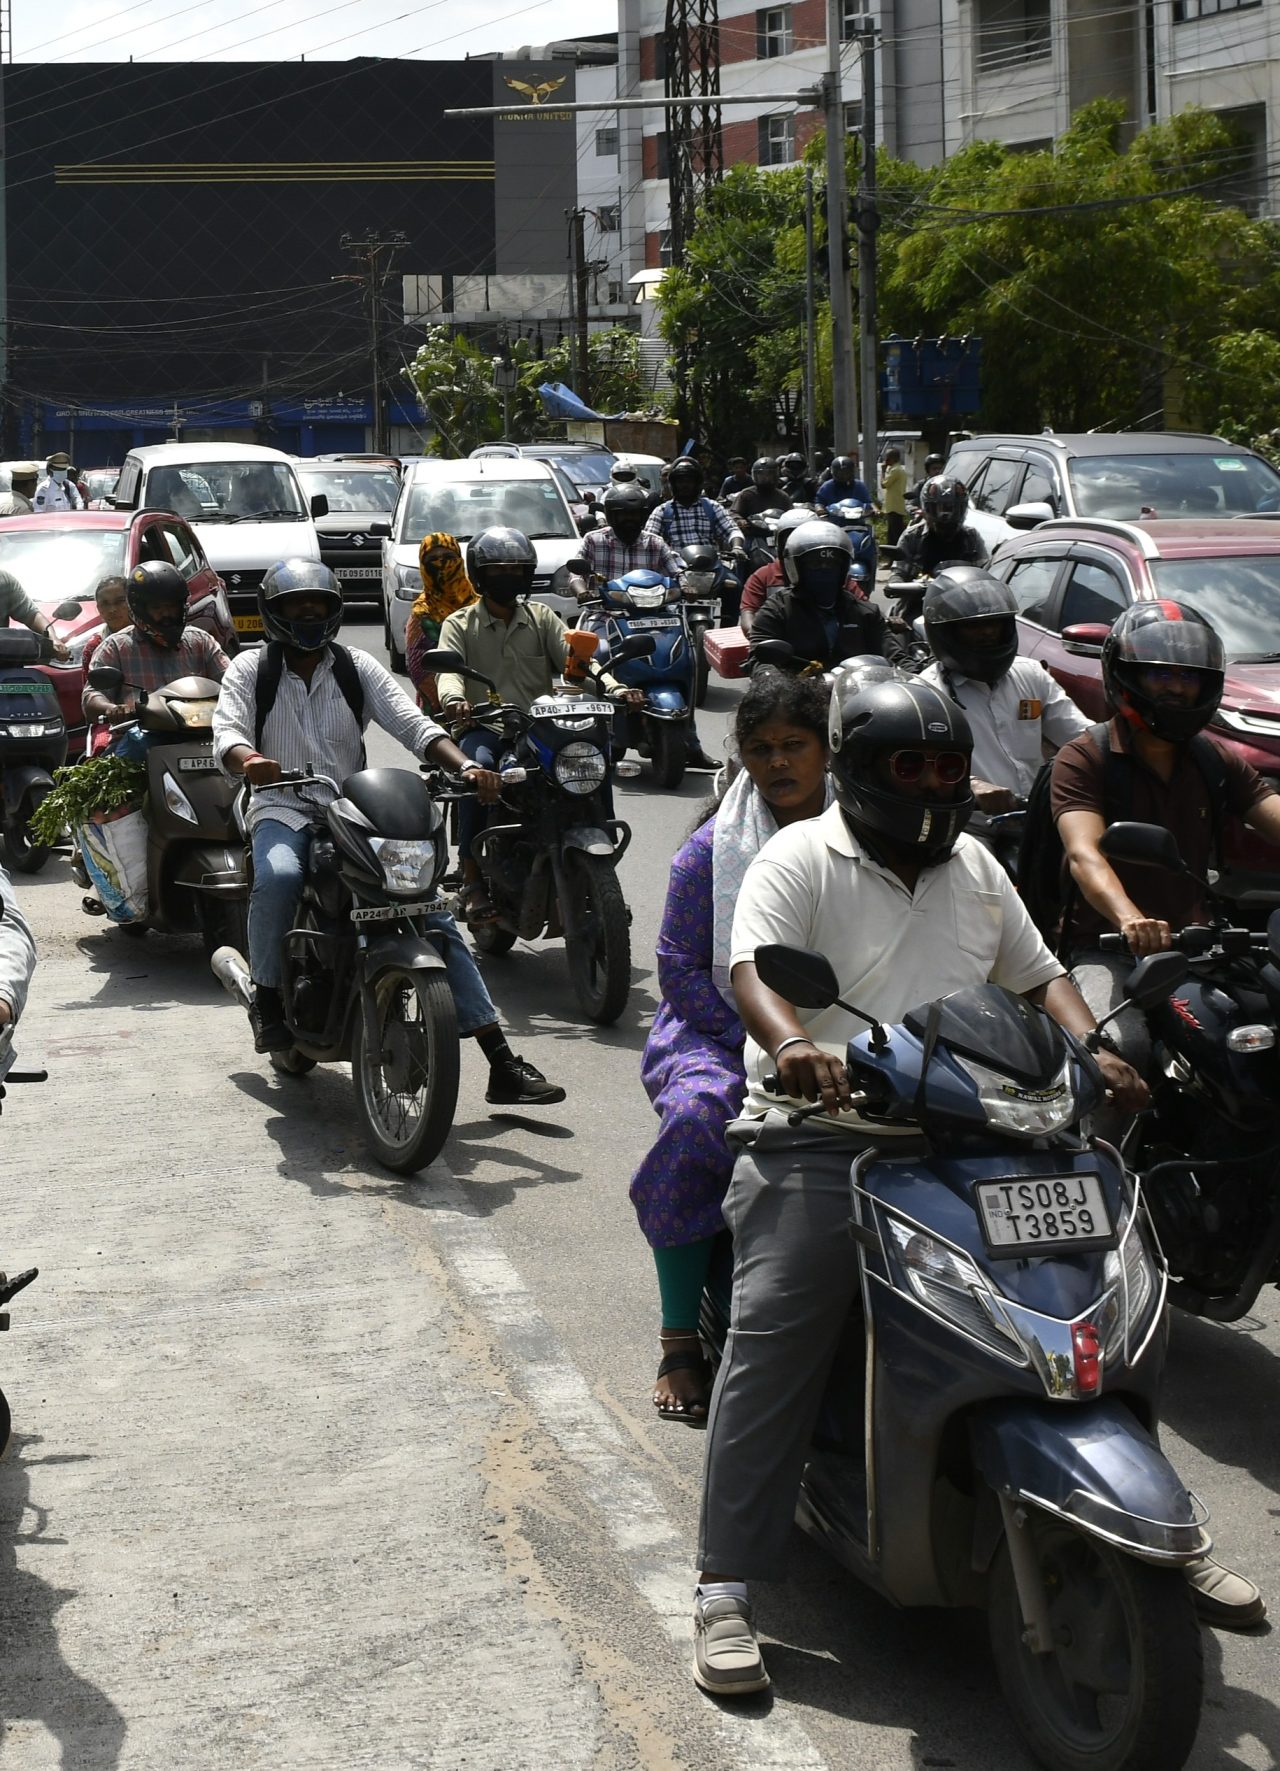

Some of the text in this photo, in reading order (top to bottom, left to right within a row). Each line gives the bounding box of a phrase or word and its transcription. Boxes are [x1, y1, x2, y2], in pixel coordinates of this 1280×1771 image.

[424, 902, 448, 913] 7947
[1000, 1179, 1087, 1212] TS08J
[1006, 1209, 1095, 1241] T3859
